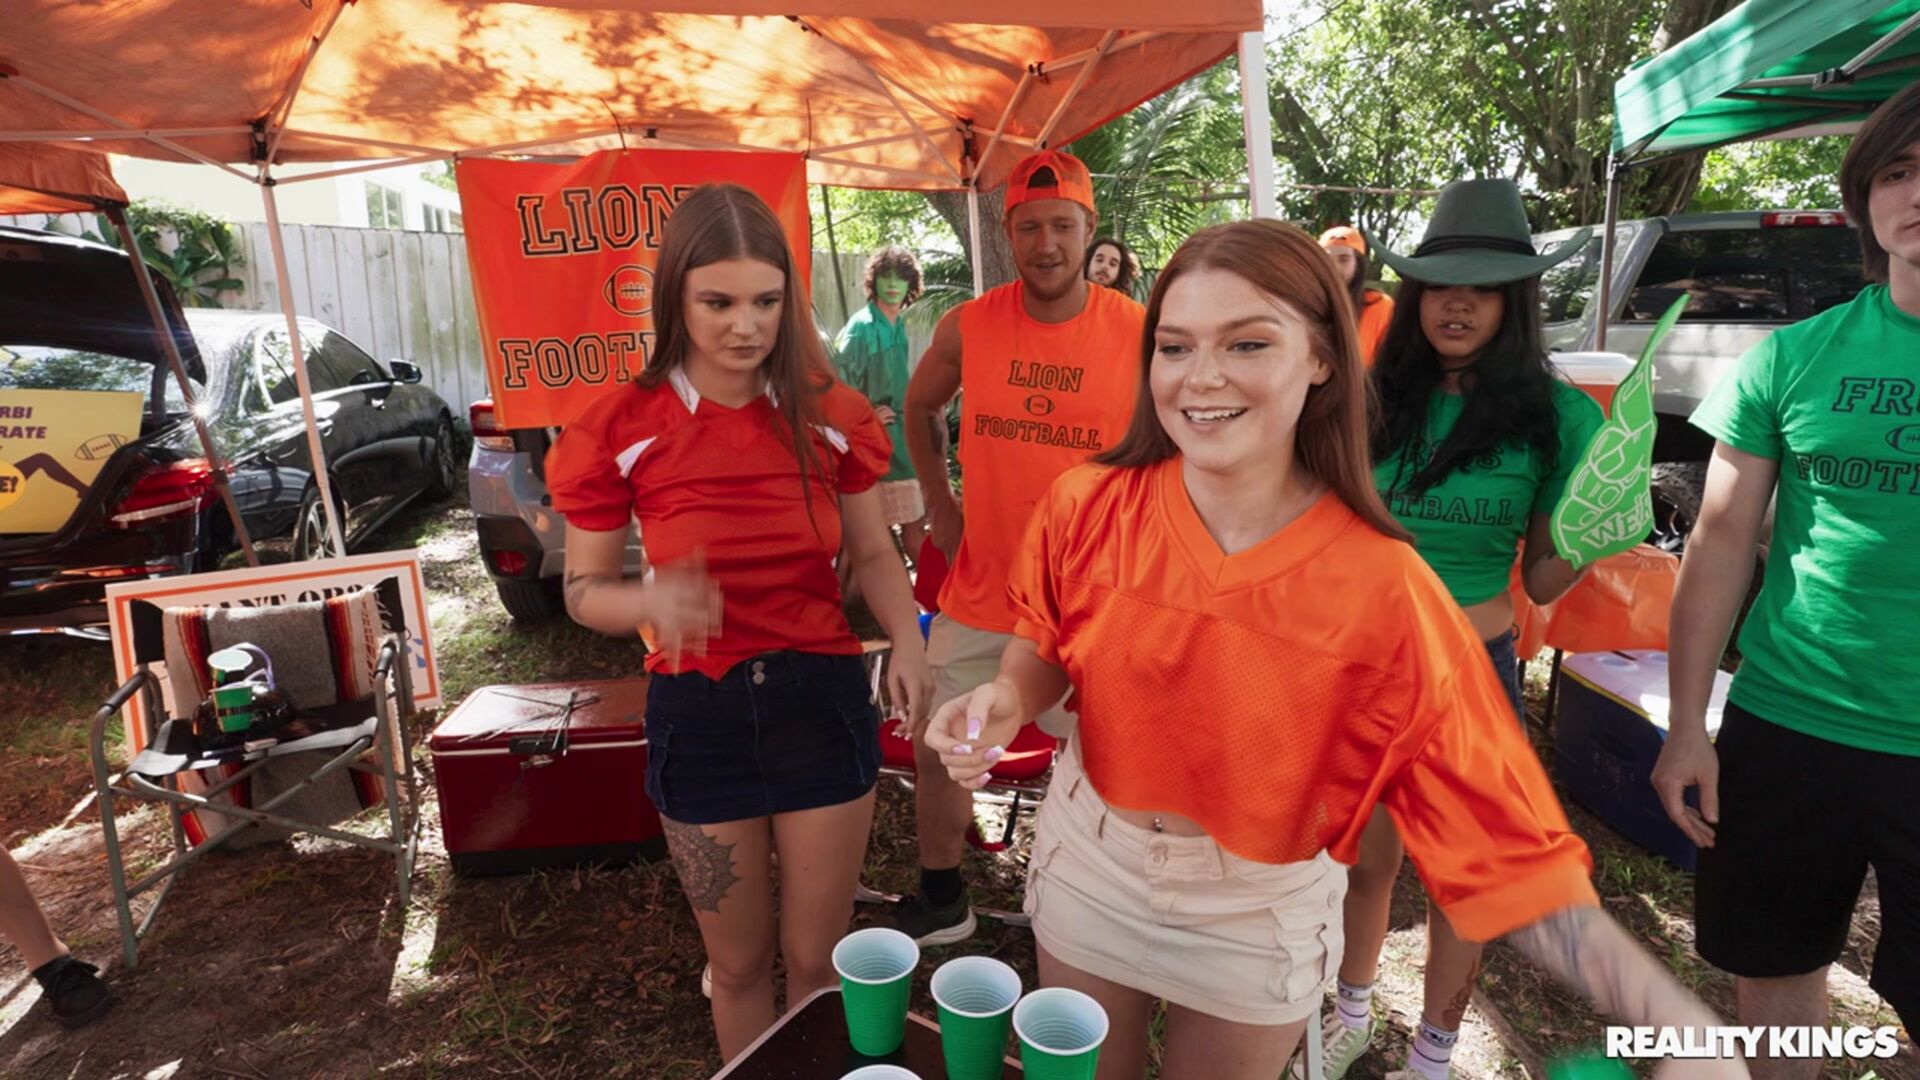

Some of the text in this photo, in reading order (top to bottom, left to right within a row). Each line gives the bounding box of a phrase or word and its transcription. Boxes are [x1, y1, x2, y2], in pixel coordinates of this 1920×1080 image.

[1008, 360, 1084, 393] LION
[1832, 377, 1920, 416] FR
[975, 414, 1102, 451] FOOTBALL
[1378, 489, 1513, 525] TBALL
